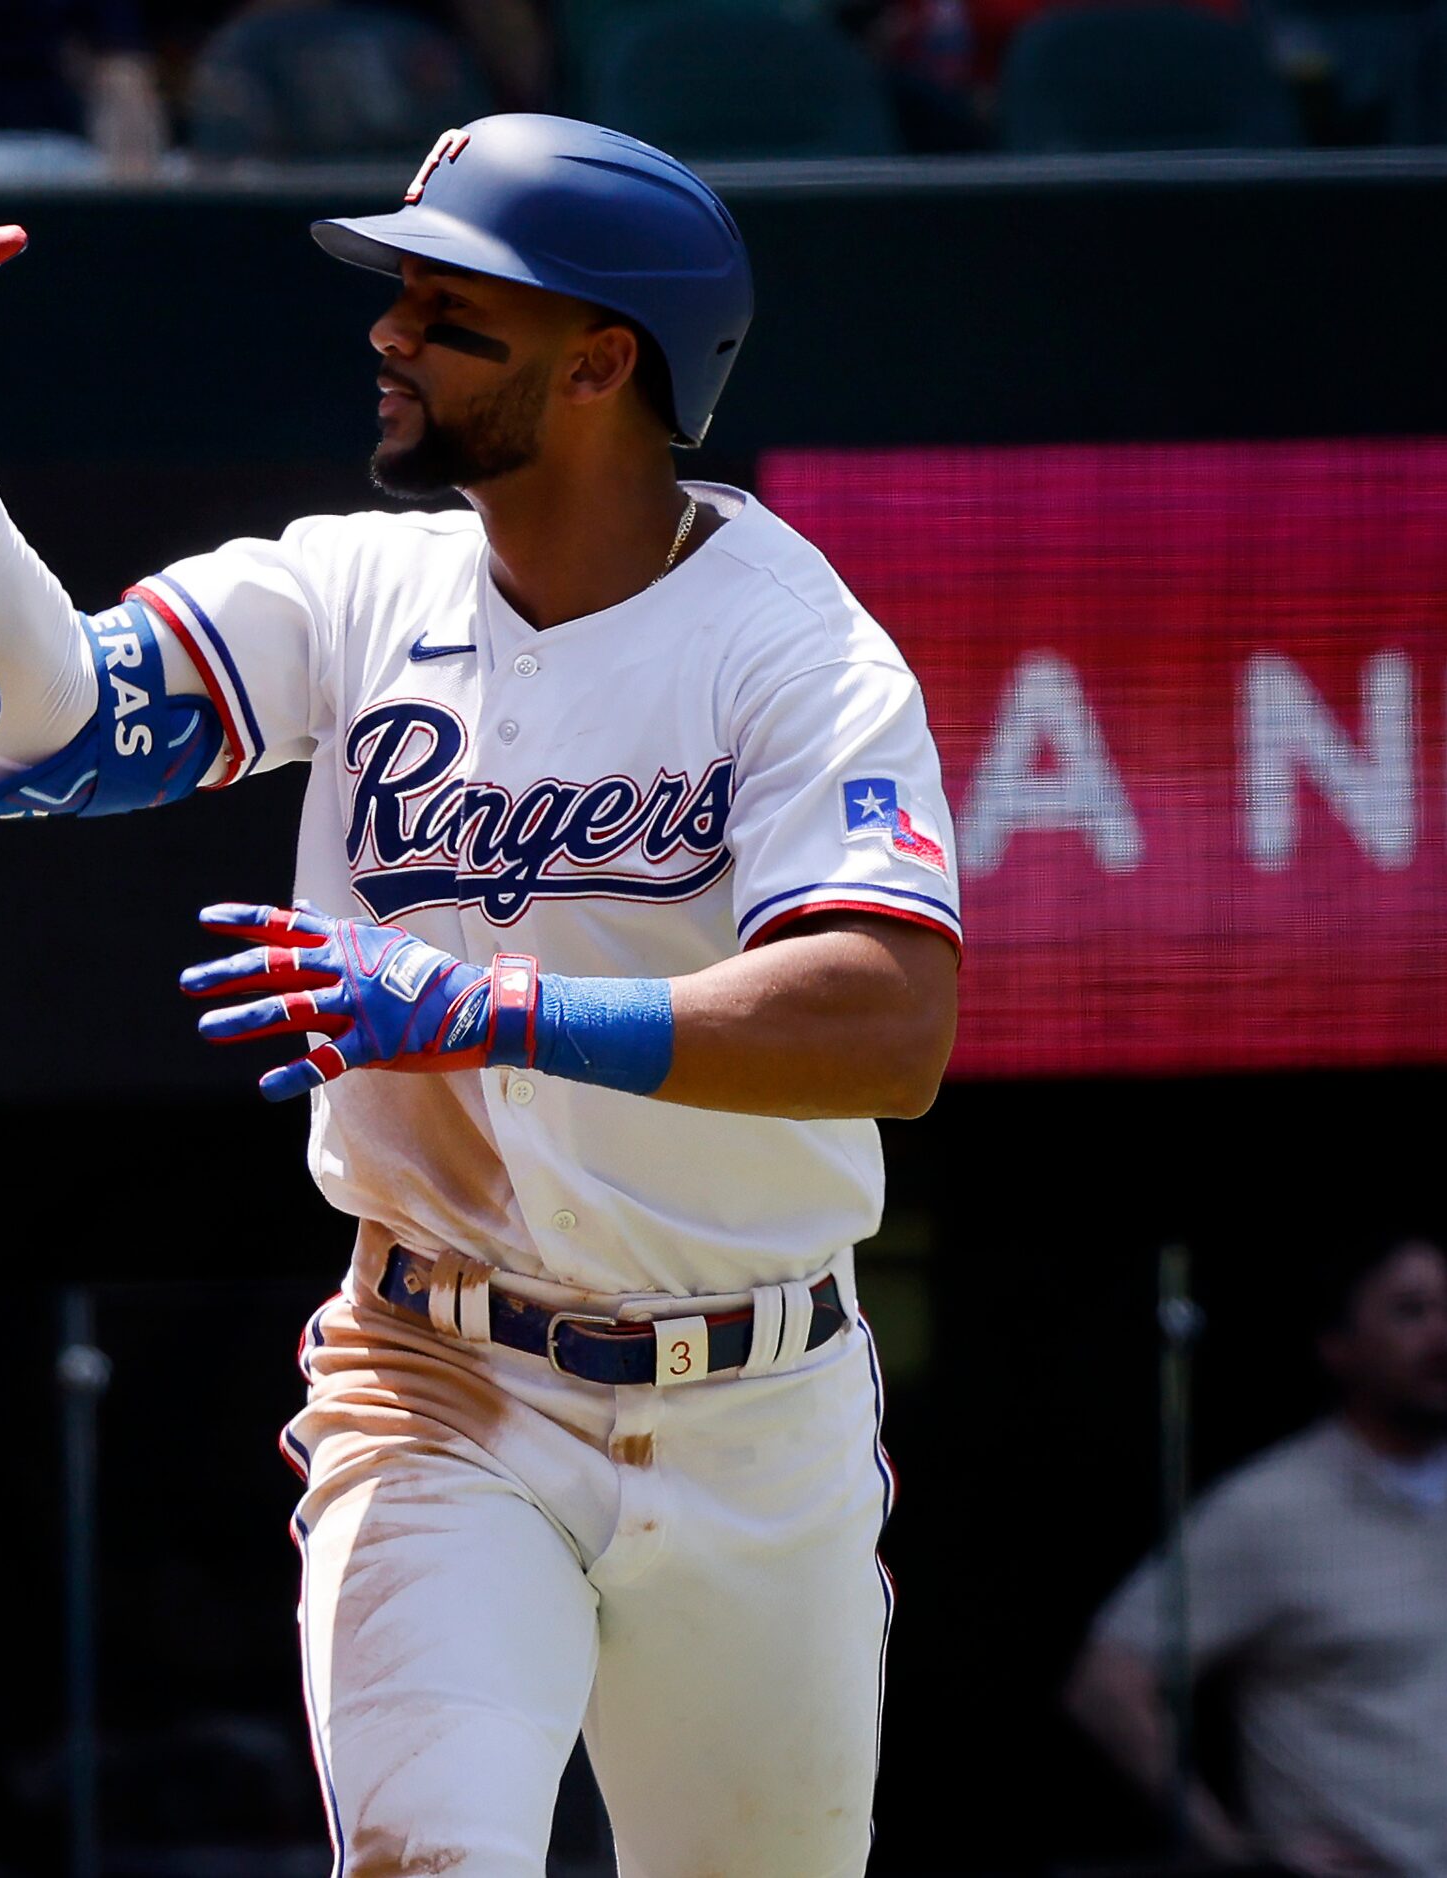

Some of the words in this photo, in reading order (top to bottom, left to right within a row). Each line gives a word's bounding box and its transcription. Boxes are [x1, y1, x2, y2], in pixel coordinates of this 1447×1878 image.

[87, 605, 153, 757] ERAS
[344, 697, 736, 928] Rangers
[669, 1340, 692, 1376] 3
